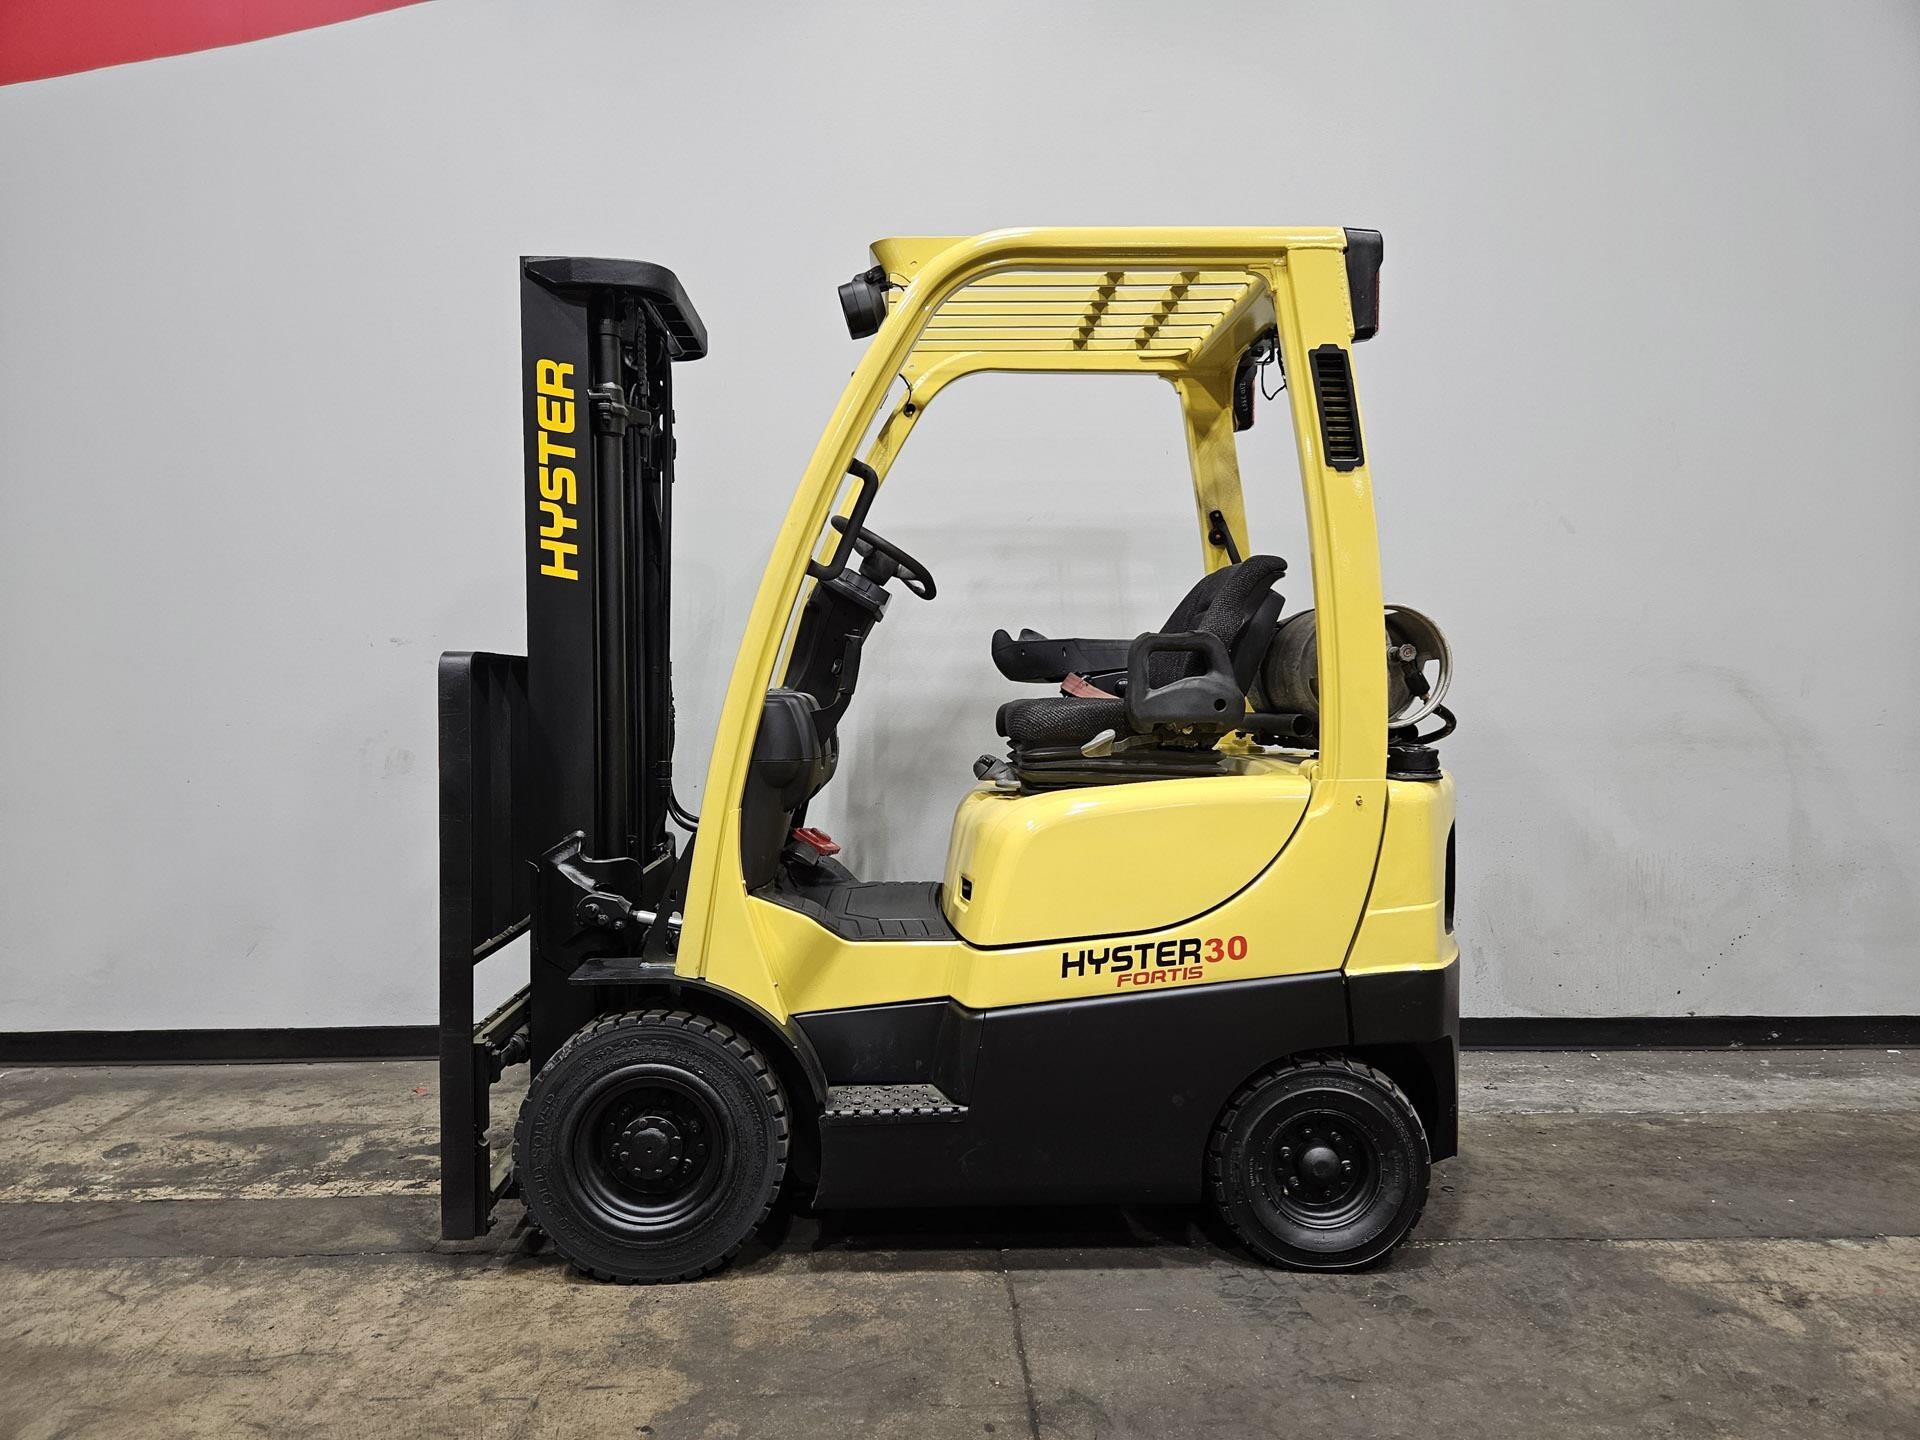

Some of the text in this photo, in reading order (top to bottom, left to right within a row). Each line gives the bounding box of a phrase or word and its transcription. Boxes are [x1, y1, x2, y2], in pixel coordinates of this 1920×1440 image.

[536, 358, 578, 581] HYSTER
[1061, 935, 1248, 978] HYSTER 30
[1116, 965, 1203, 988] FORTIS
